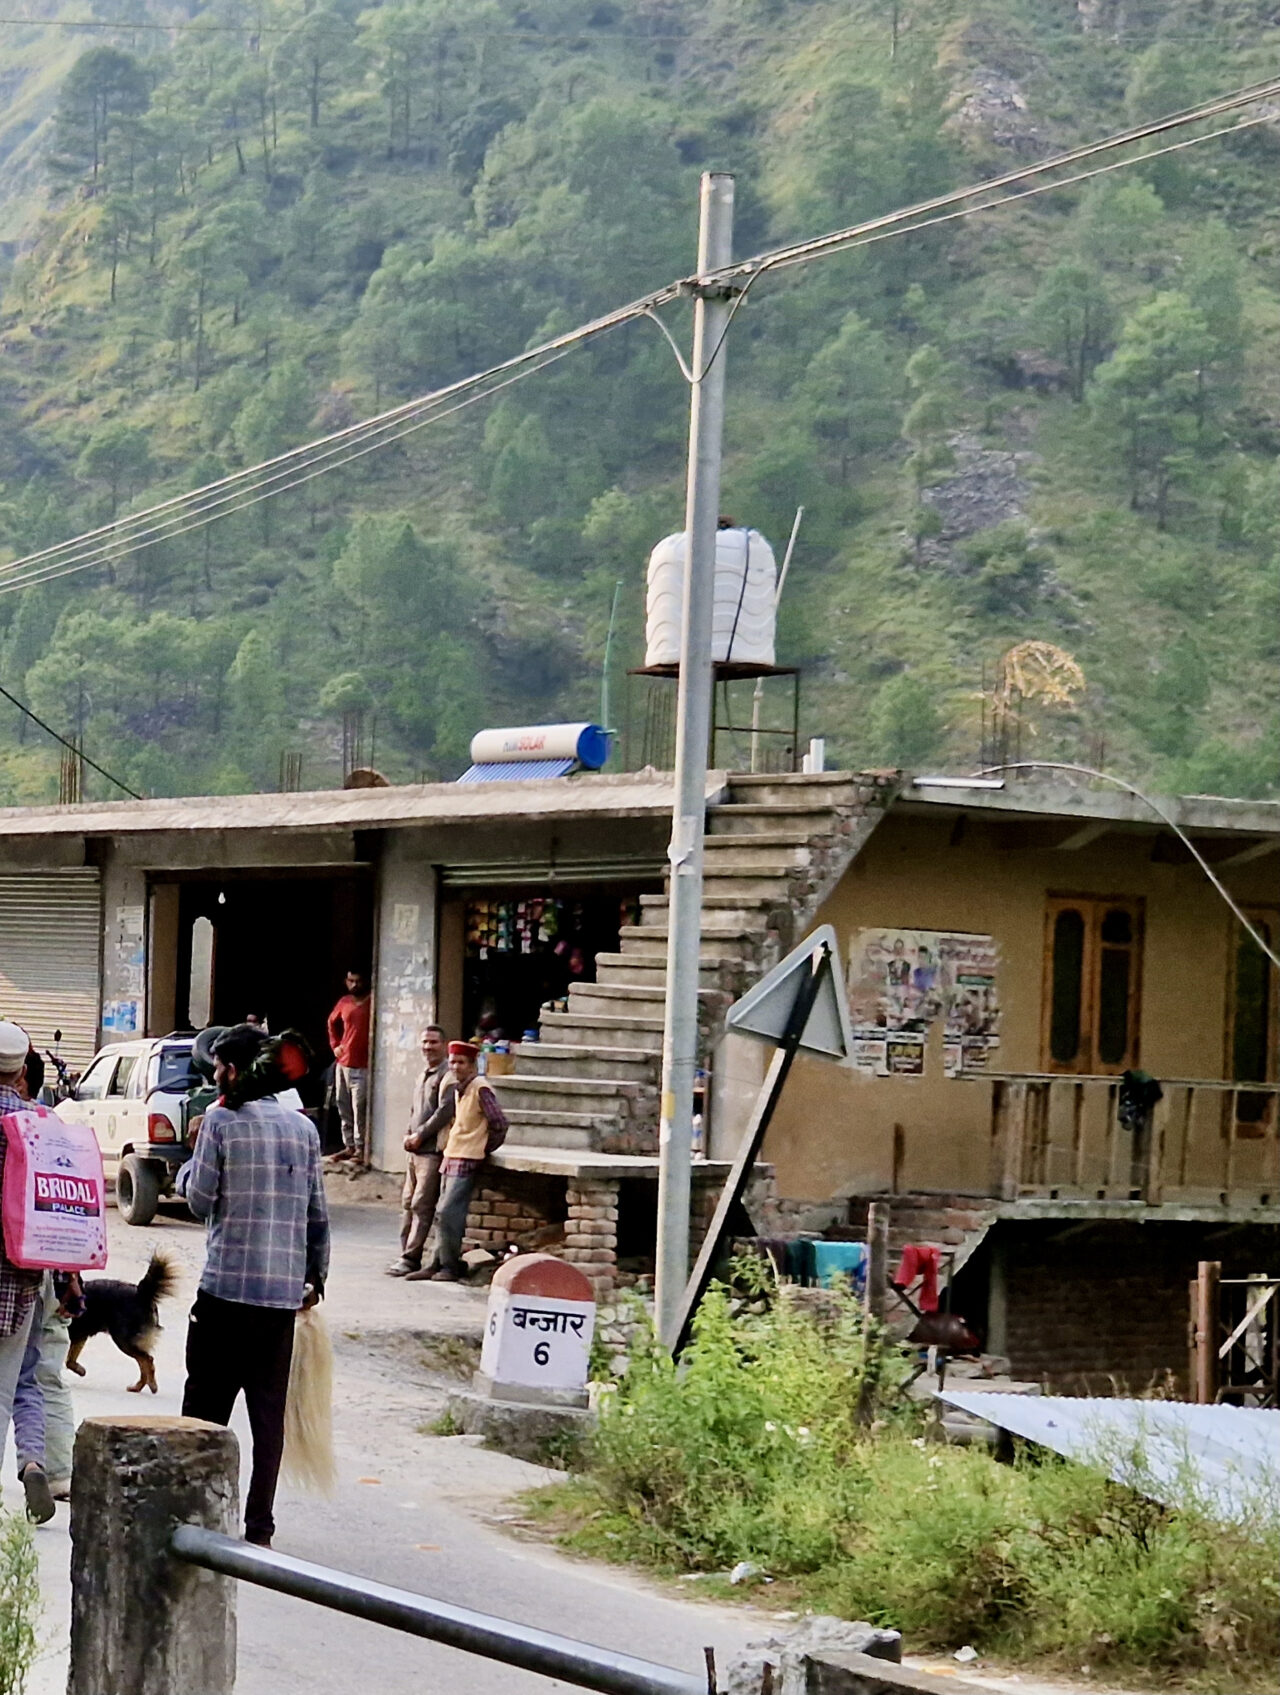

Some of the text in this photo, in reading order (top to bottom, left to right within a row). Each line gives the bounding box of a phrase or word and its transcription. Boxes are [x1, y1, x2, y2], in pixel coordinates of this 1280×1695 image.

[36, 1177, 96, 1203] BRIDAL
[52, 1203, 86, 1215] PALACE
[489, 1313, 497, 1336] 6
[512, 1307, 587, 1339] बन्जार
[534, 1342, 551, 1366] 6
